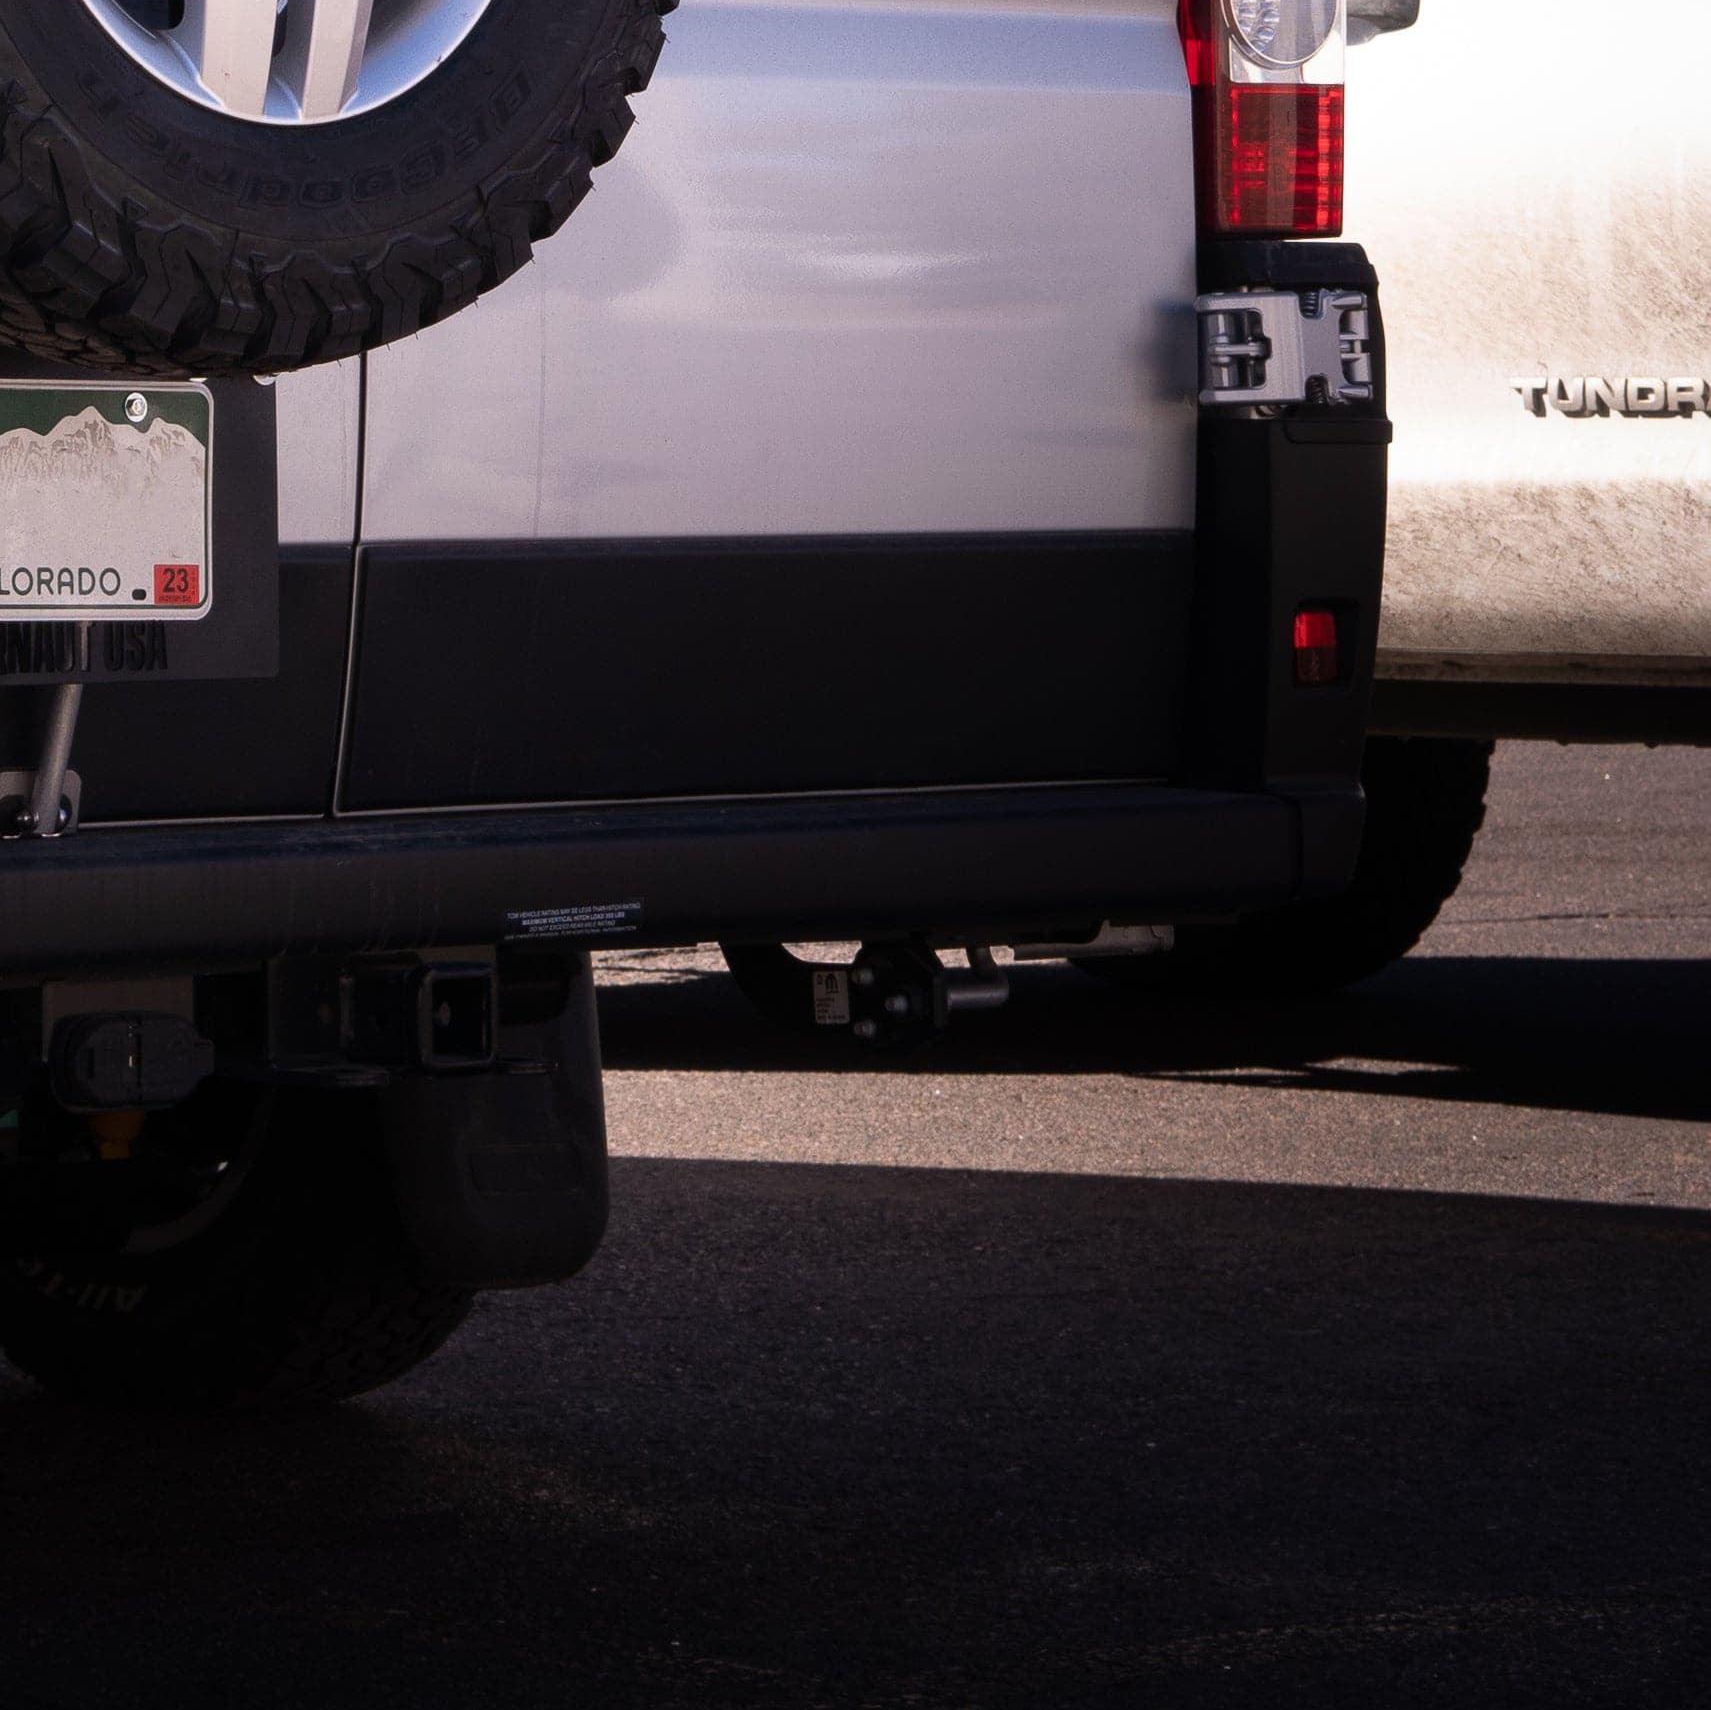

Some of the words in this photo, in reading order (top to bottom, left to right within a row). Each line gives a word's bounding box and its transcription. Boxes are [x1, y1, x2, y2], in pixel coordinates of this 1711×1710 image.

[1510, 376, 1711, 416] TUNDR
[162, 567, 189, 593] 23
[103, 620, 168, 672] USA
